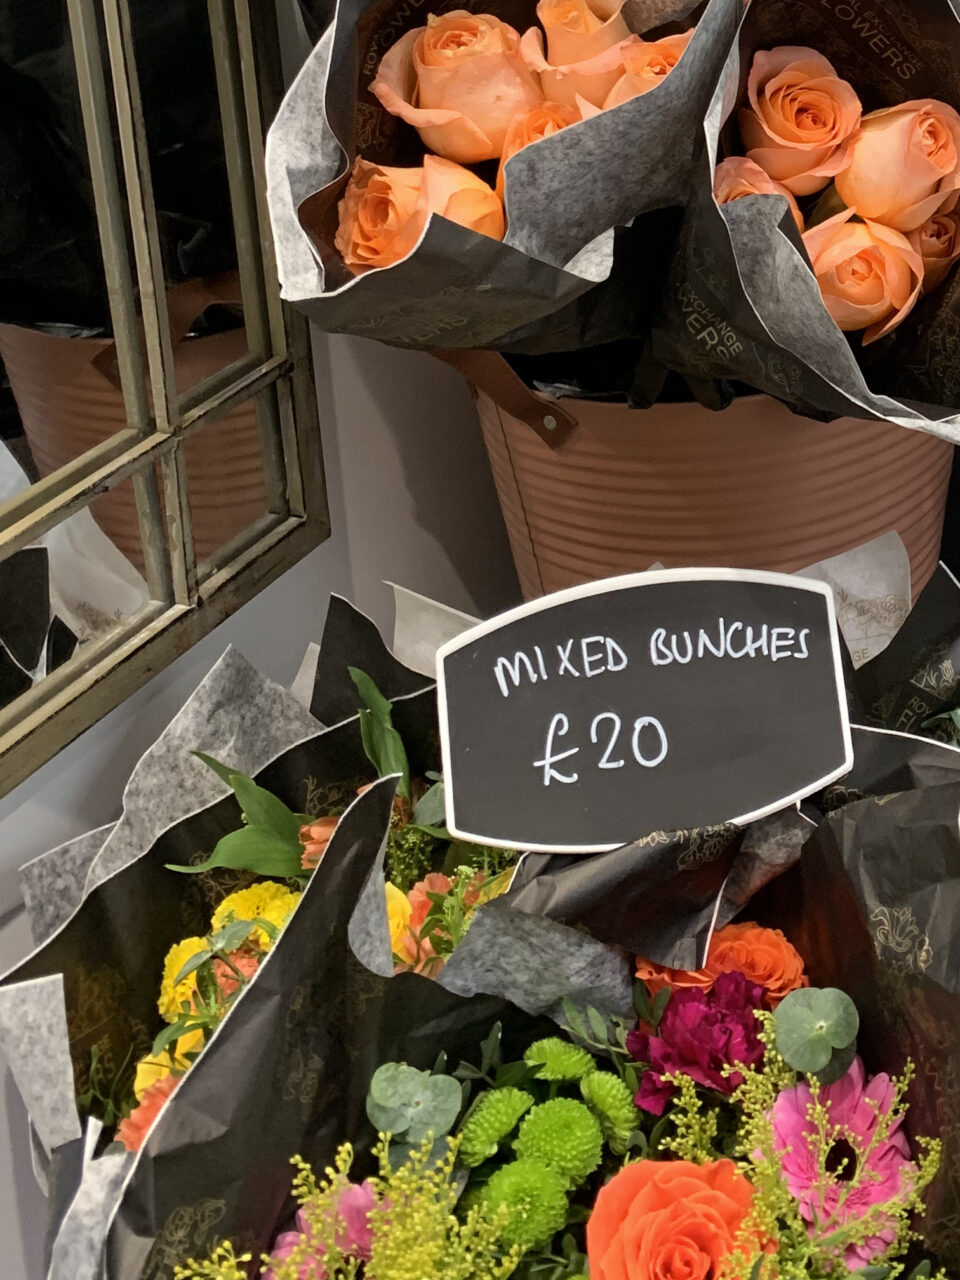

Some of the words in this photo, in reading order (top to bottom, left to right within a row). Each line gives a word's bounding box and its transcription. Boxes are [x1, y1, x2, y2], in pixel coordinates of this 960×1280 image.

[494, 634, 628, 697] MIXED
[649, 617, 810, 665] BUNCHES
[532, 712, 669, 786] £20
